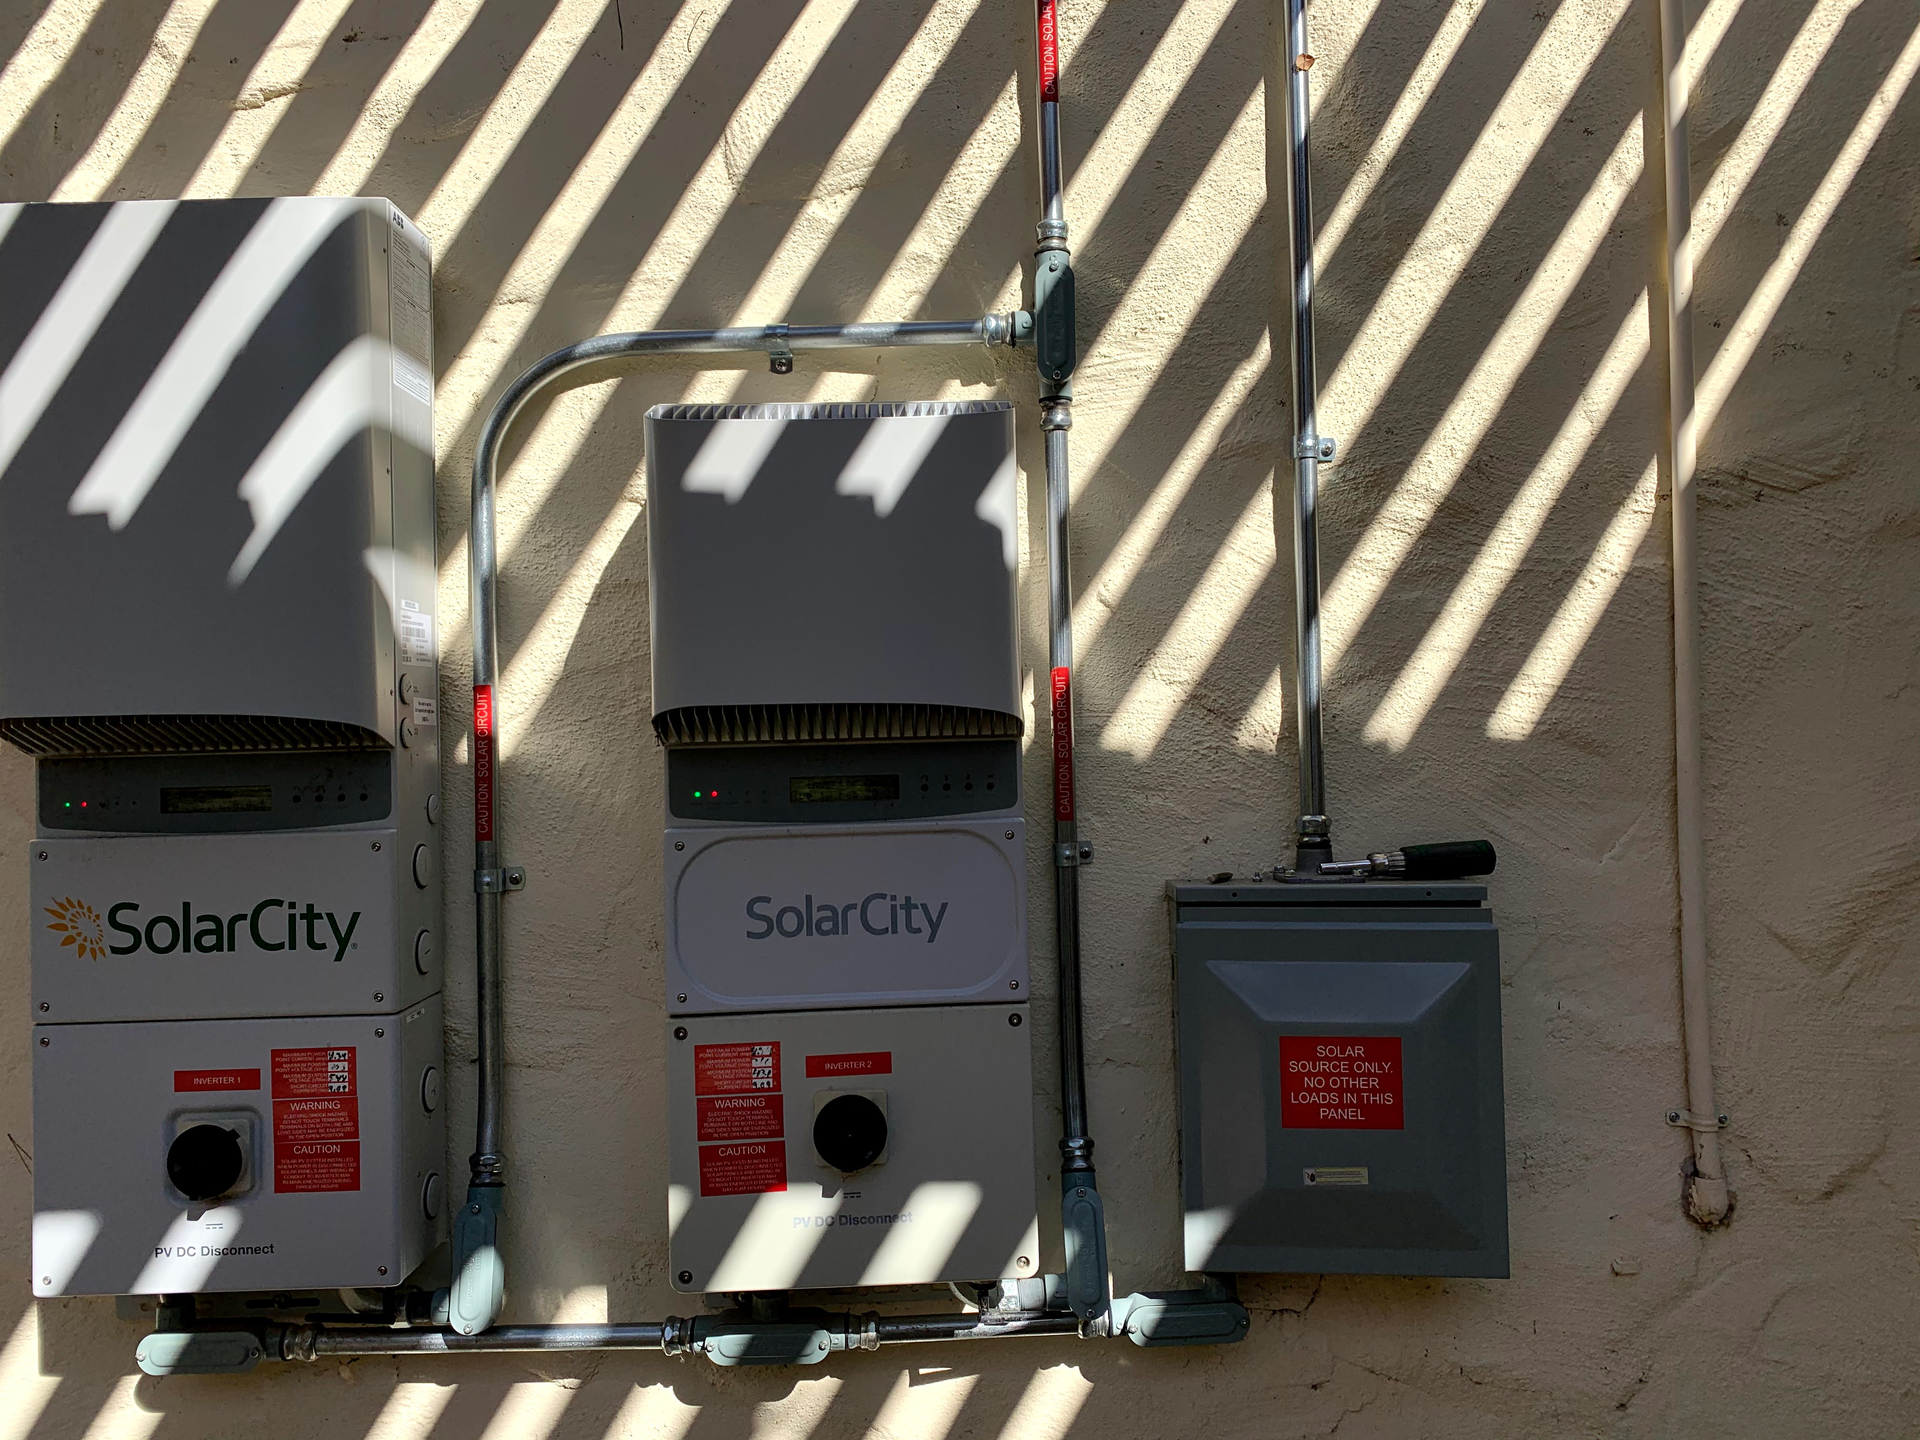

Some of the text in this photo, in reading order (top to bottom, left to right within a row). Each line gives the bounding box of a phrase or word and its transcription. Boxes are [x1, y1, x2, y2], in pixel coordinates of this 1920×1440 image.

[1043, 5, 1055, 94] CAUTION: SOLAR
[1055, 674, 1070, 814] CAUTION: SOLAR CIRCUIT
[477, 693, 489, 834] CAUTION: SOLAR CIRCUIT
[746, 892, 948, 943] SolarCity
[107, 898, 362, 962] SolarCity
[1316, 1045, 1365, 1058] SOLAR
[825, 1061, 865, 1070] INVERTER
[1289, 1061, 1393, 1073] SOURCE ONLY.
[194, 1077, 235, 1085] INVERTER
[1304, 1077, 1380, 1089] NO OTHER
[715, 1098, 765, 1108] WARNING
[1291, 1092, 1393, 1105] LOADS IN THIS
[290, 1101, 340, 1111] WARNING
[1320, 1108, 1365, 1120] PANEL
[293, 1145, 340, 1154] CAUTION
[719, 1145, 765, 1156] CAUTION
[793, 1212, 913, 1228] PV DC Disconnect
[155, 1244, 275, 1258] PV DC Disconnect
